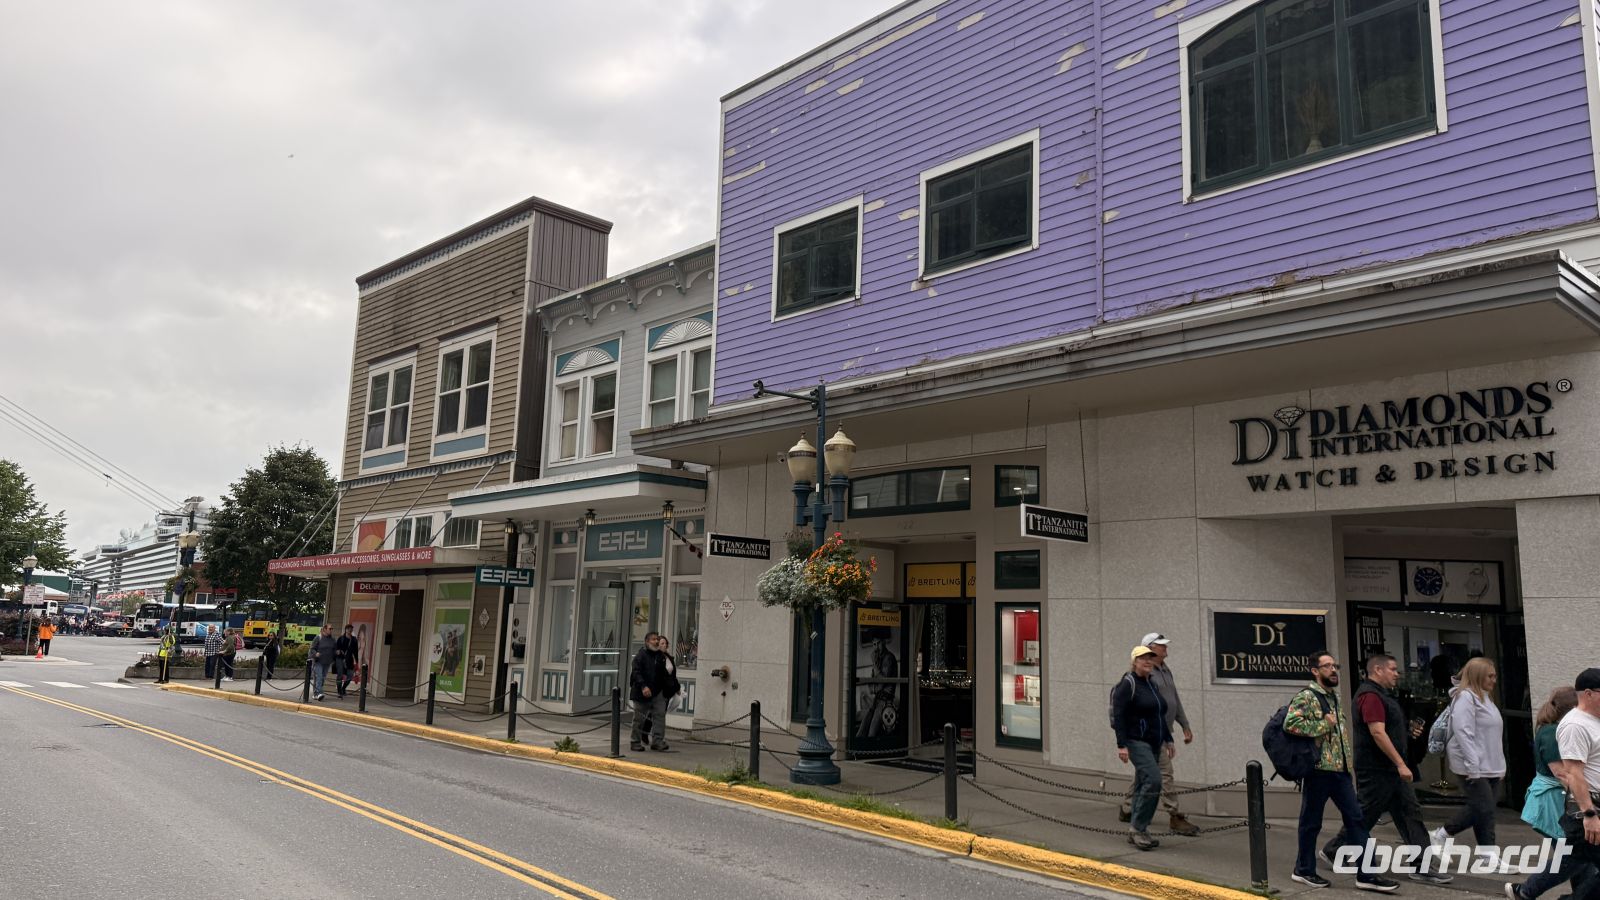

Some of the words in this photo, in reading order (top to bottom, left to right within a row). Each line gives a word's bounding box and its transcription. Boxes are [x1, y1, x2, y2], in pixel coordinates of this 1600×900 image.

[1229, 406, 1305, 465] Di
[1308, 416, 1556, 459] INTERNATIONAL
[1247, 467, 1357, 492] WATCH
[1375, 464, 1396, 483] &
[1414, 451, 1556, 480] DESIGN
[1042, 515, 1084, 530] TANZANITE
[1042, 525, 1086, 537] INTERNATIONAL
[726, 540, 768, 551] TANZANITE
[381, 551, 411, 562] SUNGLASSES
[416, 550, 432, 560] MORE
[725, 548, 768, 557] INTERNATIONAL
[918, 578, 961, 586] BREITLING
[867, 614, 899, 622] BREITLING
[1252, 622, 1287, 646] Di
[1362, 627, 1382, 645] FREE
[1221, 652, 1247, 671] Di
[1248, 654, 1310, 666] DIAMOND
